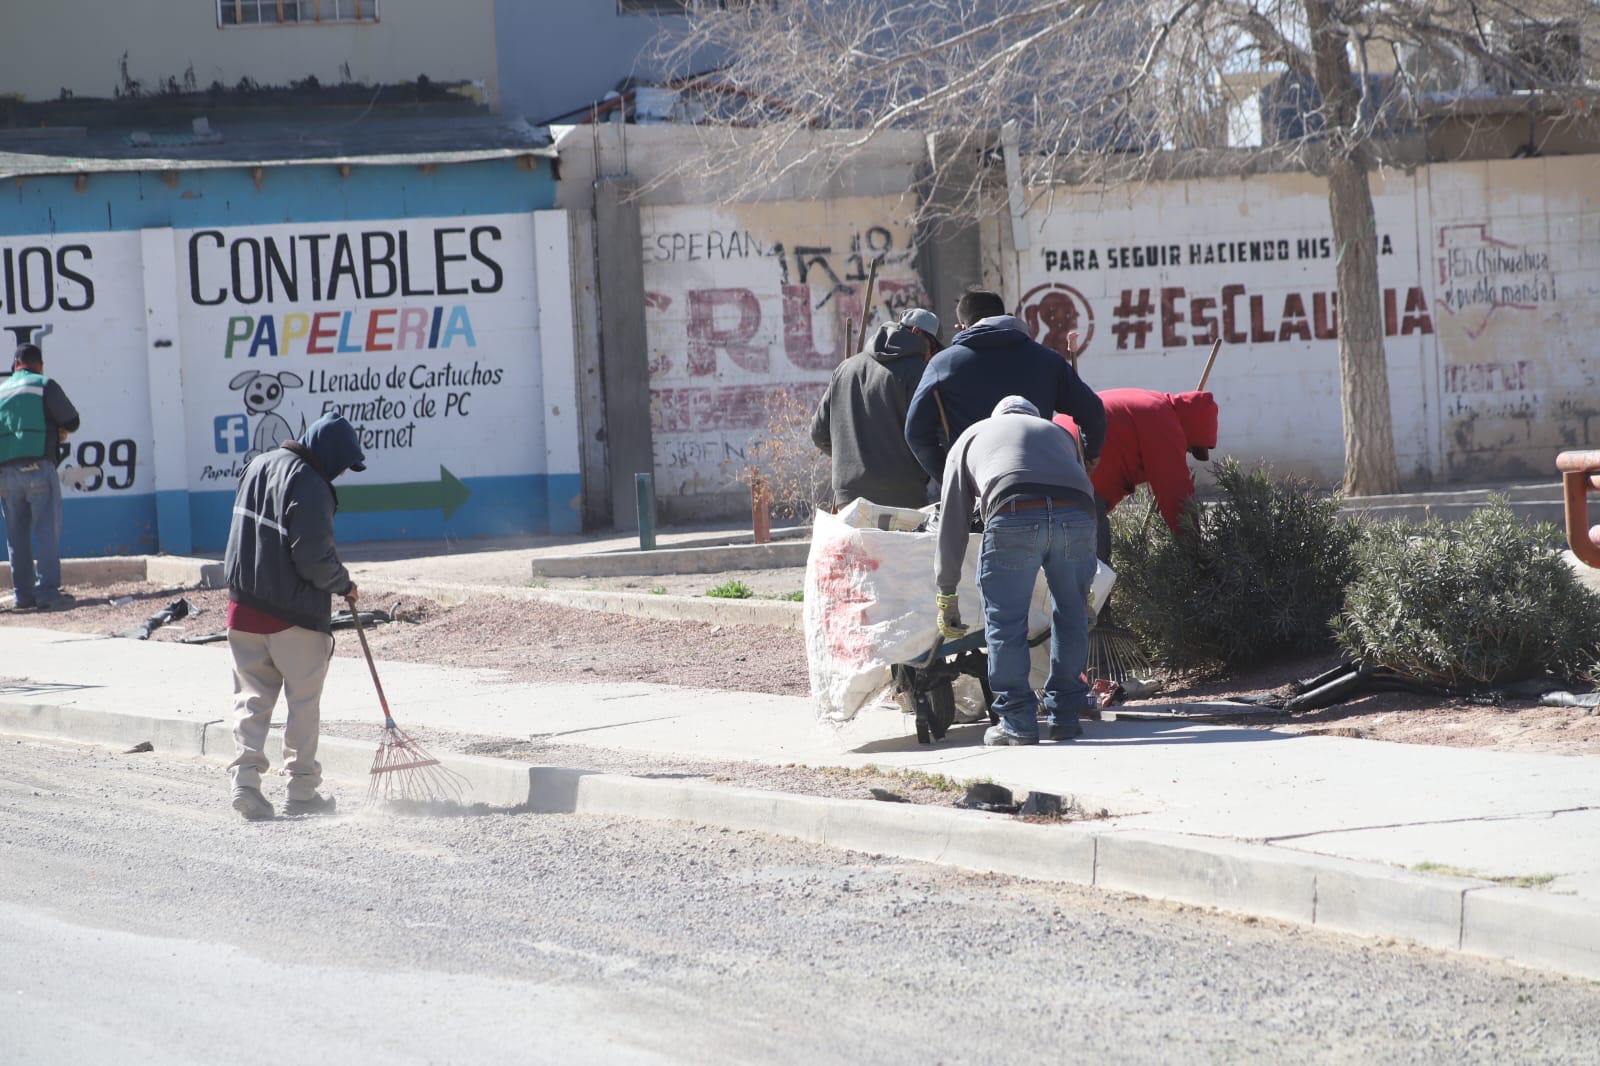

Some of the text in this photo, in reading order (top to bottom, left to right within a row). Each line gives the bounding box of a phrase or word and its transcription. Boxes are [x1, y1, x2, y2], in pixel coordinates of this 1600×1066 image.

[188, 225, 504, 306] CONTABLES
[1045, 234, 1394, 272] PARA SEGUIR HACIENDO HISIA
[0, 244, 95, 314] IOS
[224, 305, 476, 359] PAPELERIA
[386, 365, 407, 389] de
[409, 361, 504, 390] Cartuchos
[413, 392, 437, 419] de
[444, 391, 472, 418] PC
[356, 421, 416, 450] ternet
